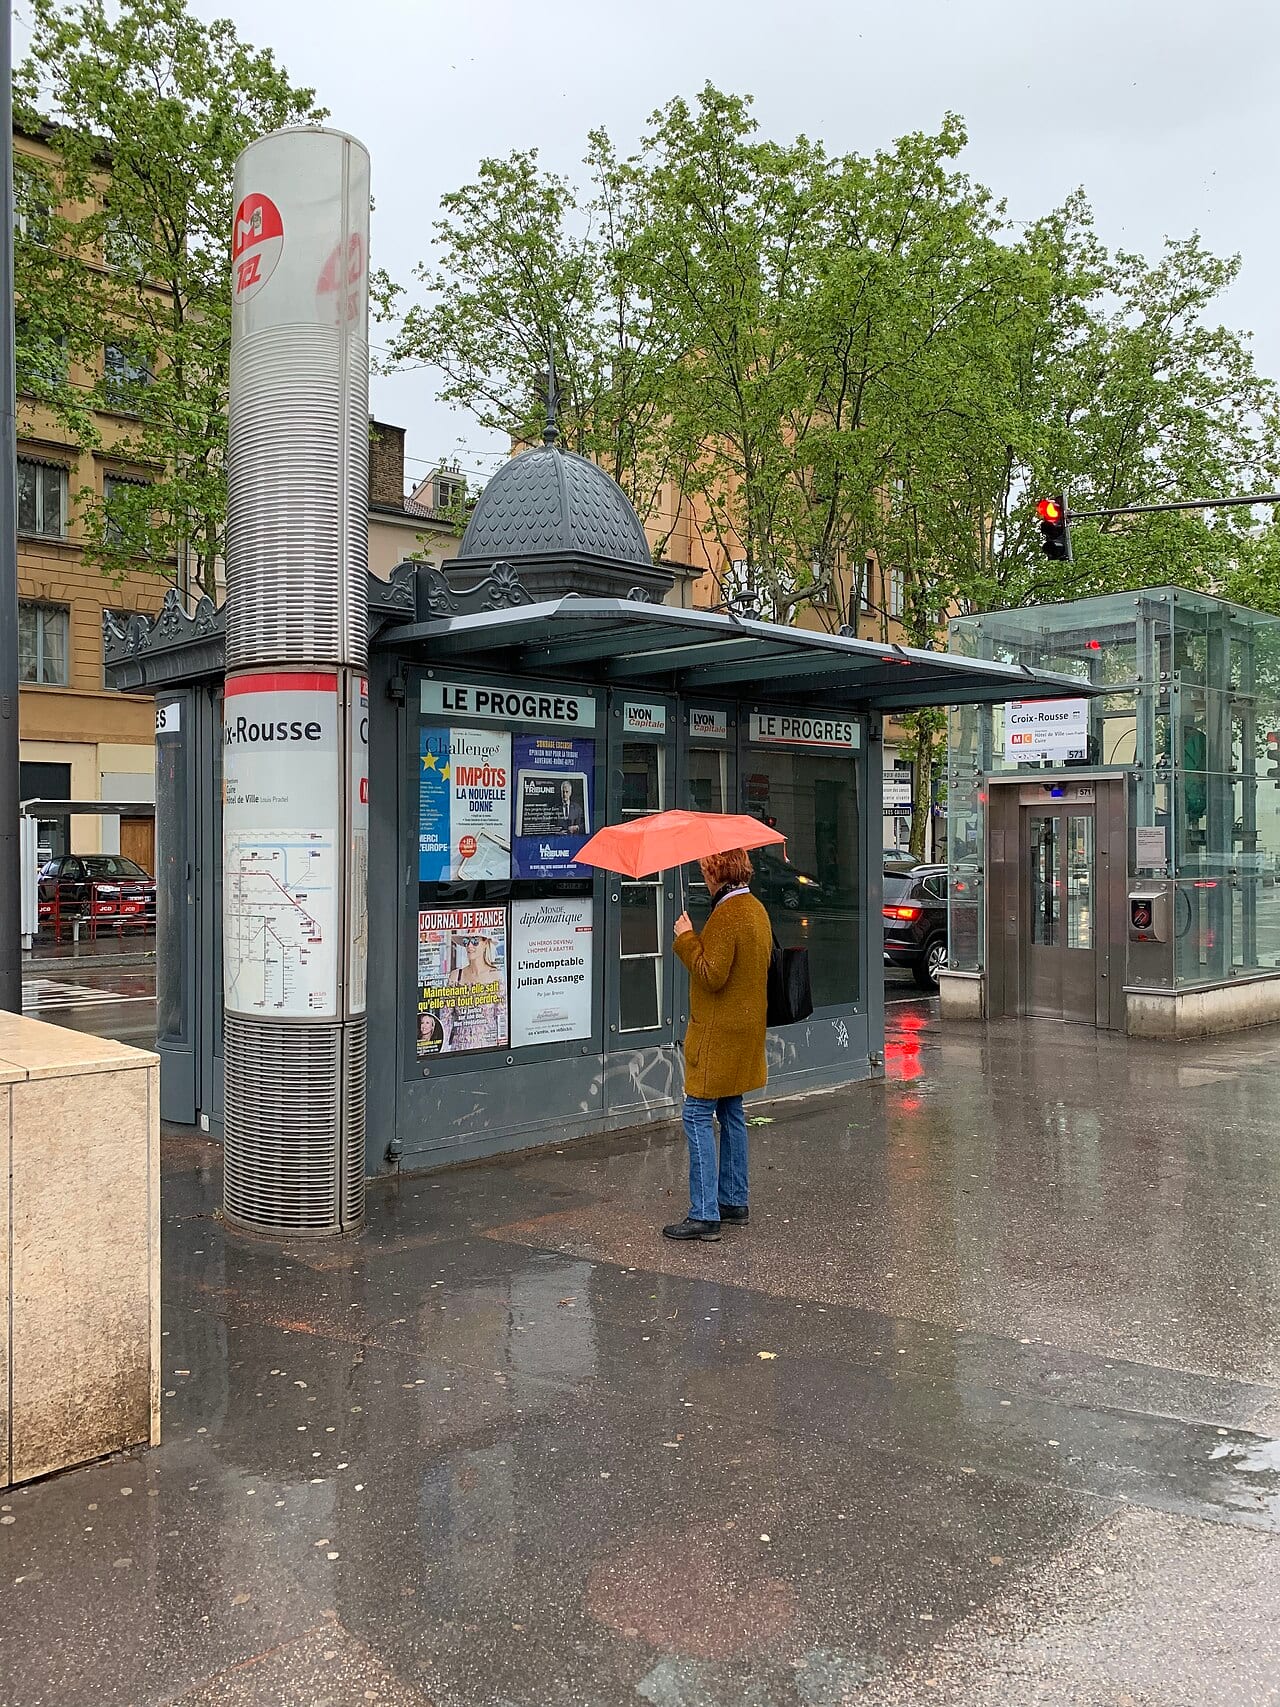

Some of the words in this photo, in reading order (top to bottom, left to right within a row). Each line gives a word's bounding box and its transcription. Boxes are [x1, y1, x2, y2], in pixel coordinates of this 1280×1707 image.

[237, 206, 263, 250] M
[443, 687, 467, 711] LE
[476, 690, 578, 721] PROGRÈS
[628, 707, 652, 721] LYON
[694, 713, 715, 726] LYON
[1011, 712, 1069, 724] Croix-Rousse
[628, 718, 665, 729] Capitale
[694, 723, 727, 734] Capitale
[758, 716, 776, 736] LE
[781, 718, 852, 742] PROGRÈS
[1013, 735, 1021, 744] M
[425, 737, 501, 763] Challenges
[1069, 750, 1083, 759] 571
[456, 763, 506, 787] IMPÔTS
[456, 788, 466, 800] LA
[468, 788, 506, 801] NOUVELLE
[524, 786, 555, 794] TRIBUNE
[1079, 788, 1091, 796] 571
[245, 794, 259, 803] Ville
[469, 801, 493, 812] DONNE
[539, 843, 550, 851] LA
[420, 911, 460, 930] JOURNAL
[462, 913, 473, 928] DE
[475, 909, 504, 928] FRANCE
[520, 913, 583, 927] diplomatique
[518, 957, 584, 970] L'indomptable
[517, 976, 544, 989] Julian
[546, 974, 585, 984] Assange
[423, 984, 469, 999] Maintenant,
[471, 983, 485, 994] elle
[485, 981, 499, 992] sait
[418, 997, 444, 1012] qu'elle
[446, 999, 456, 1008] va
[458, 995, 473, 1007] tout
